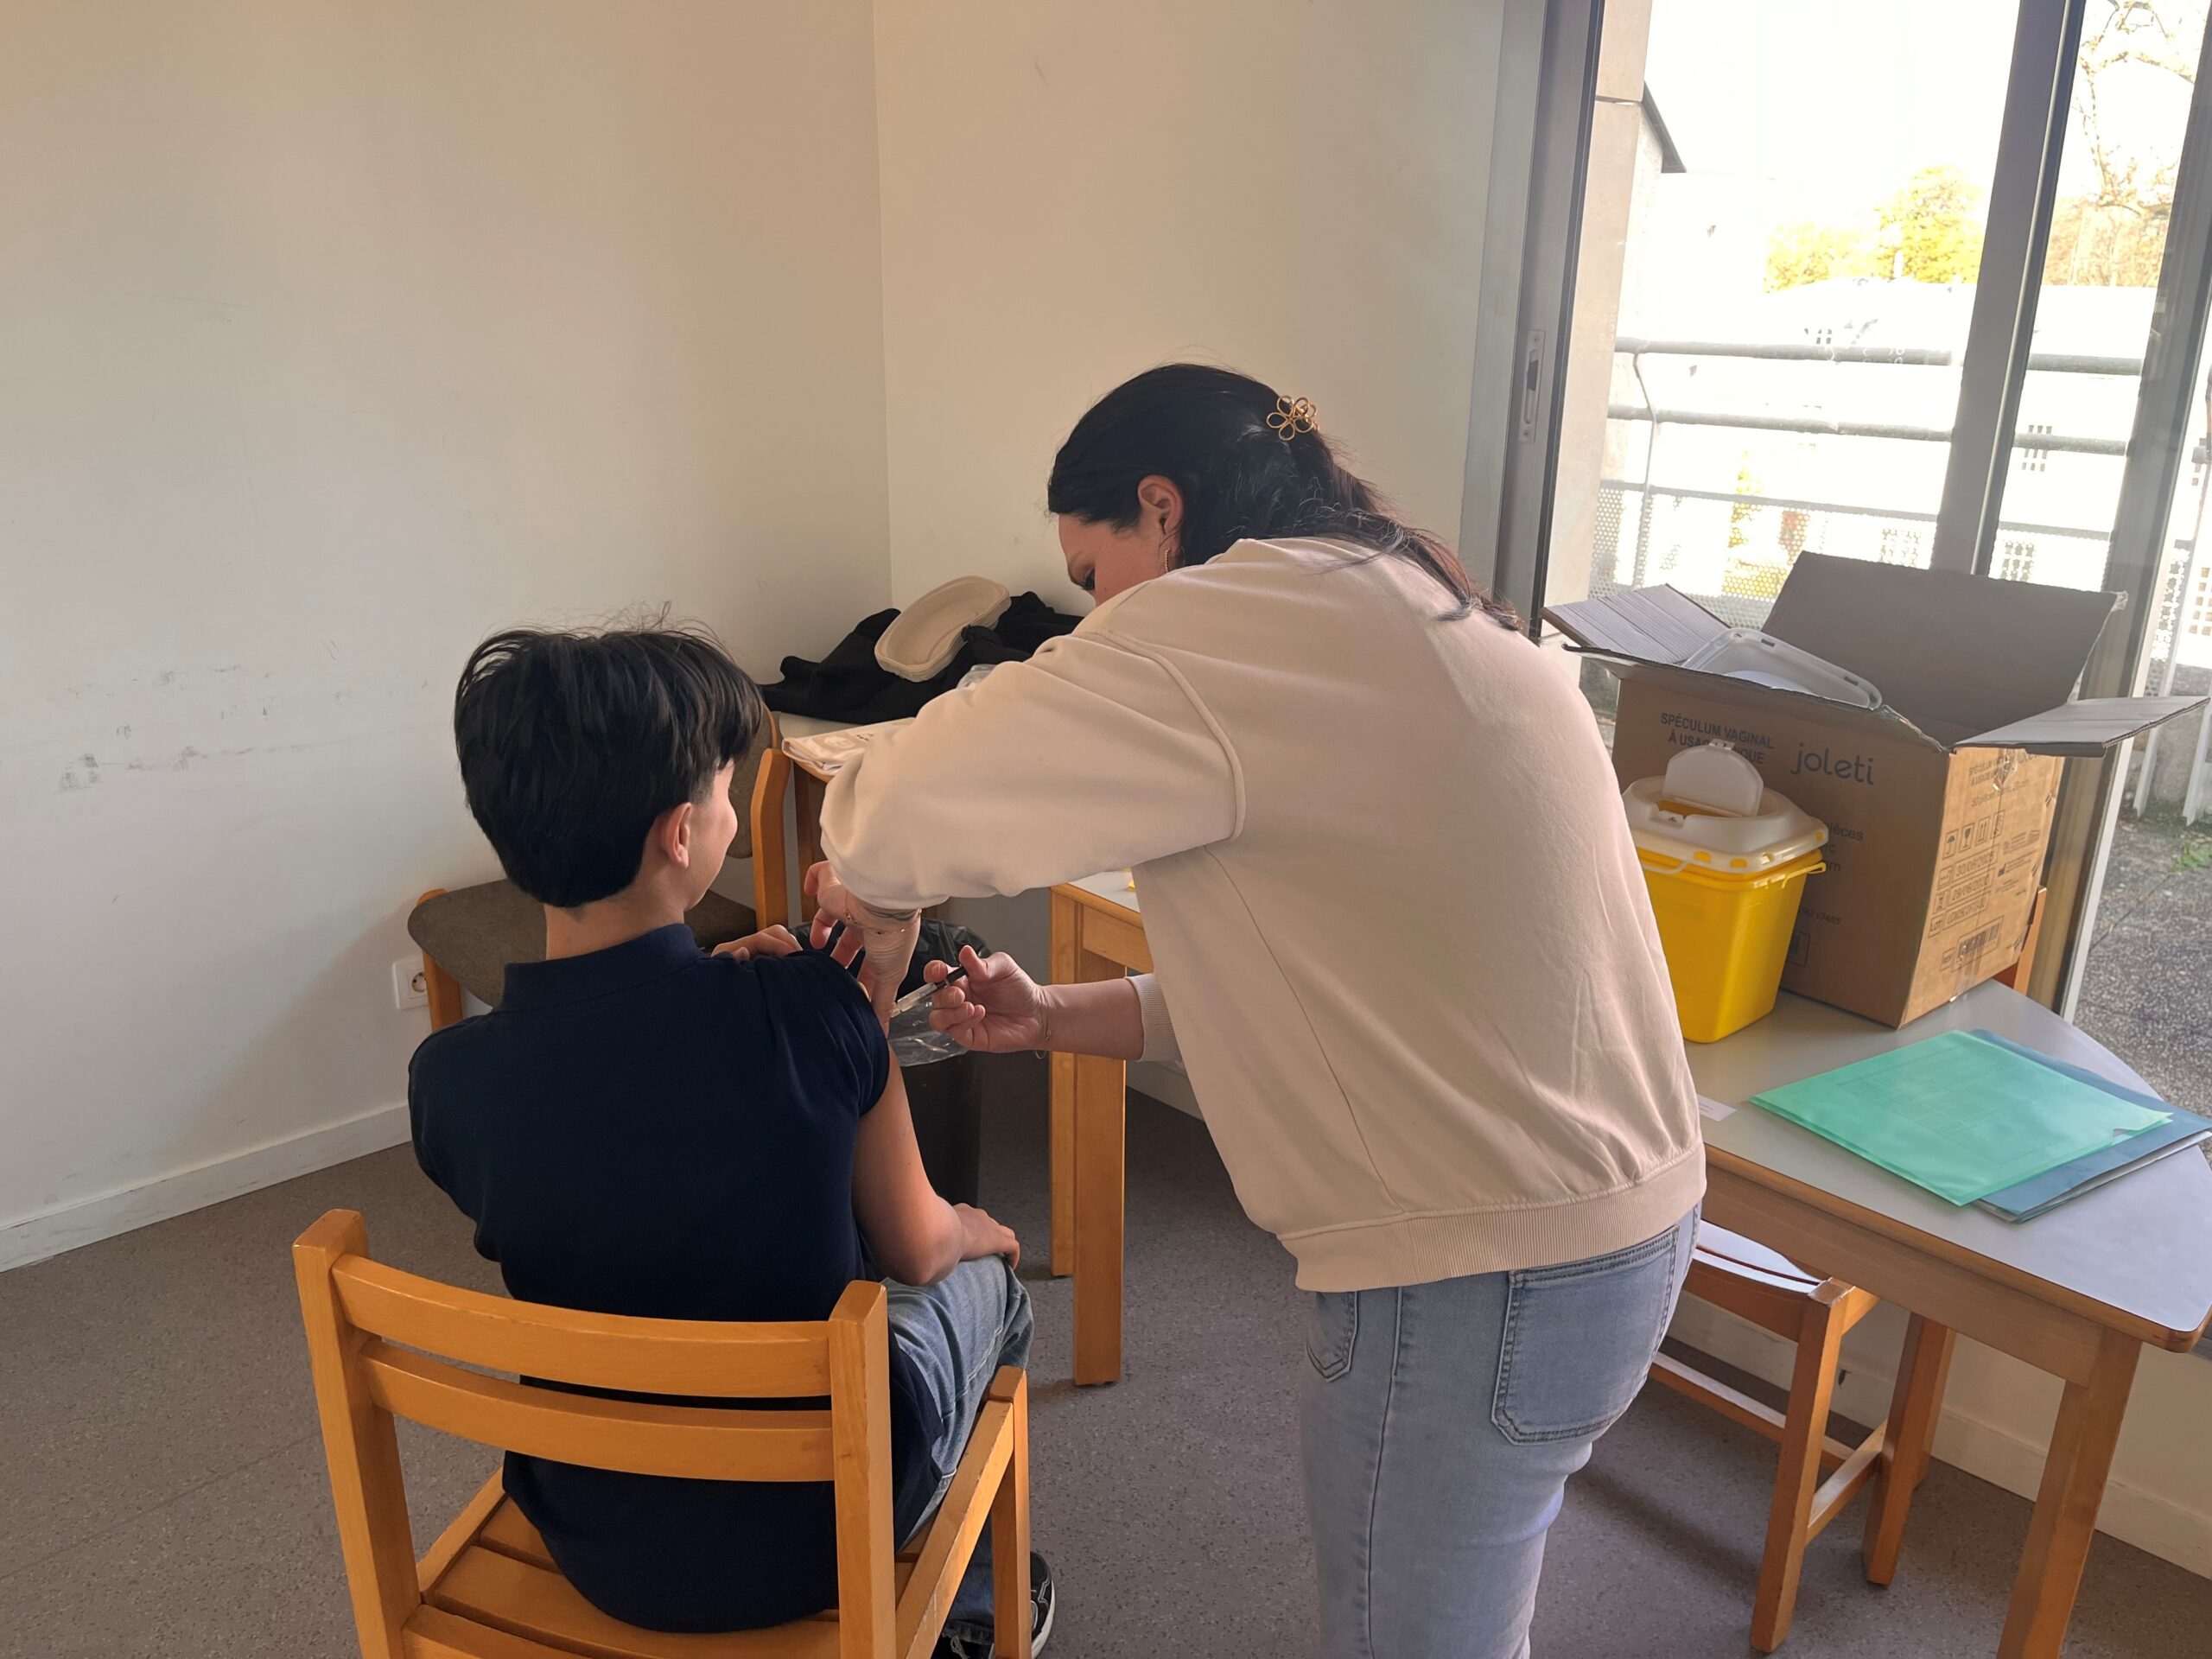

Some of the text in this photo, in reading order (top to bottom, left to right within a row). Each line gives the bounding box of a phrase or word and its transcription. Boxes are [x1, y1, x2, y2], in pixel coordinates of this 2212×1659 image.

[1661, 713, 1774, 750] SPÉCULUM VAGINAL
[1789, 741, 1874, 785] joleti
[1829, 823, 1864, 841] ièces
[1929, 918, 1943, 932] LOT
